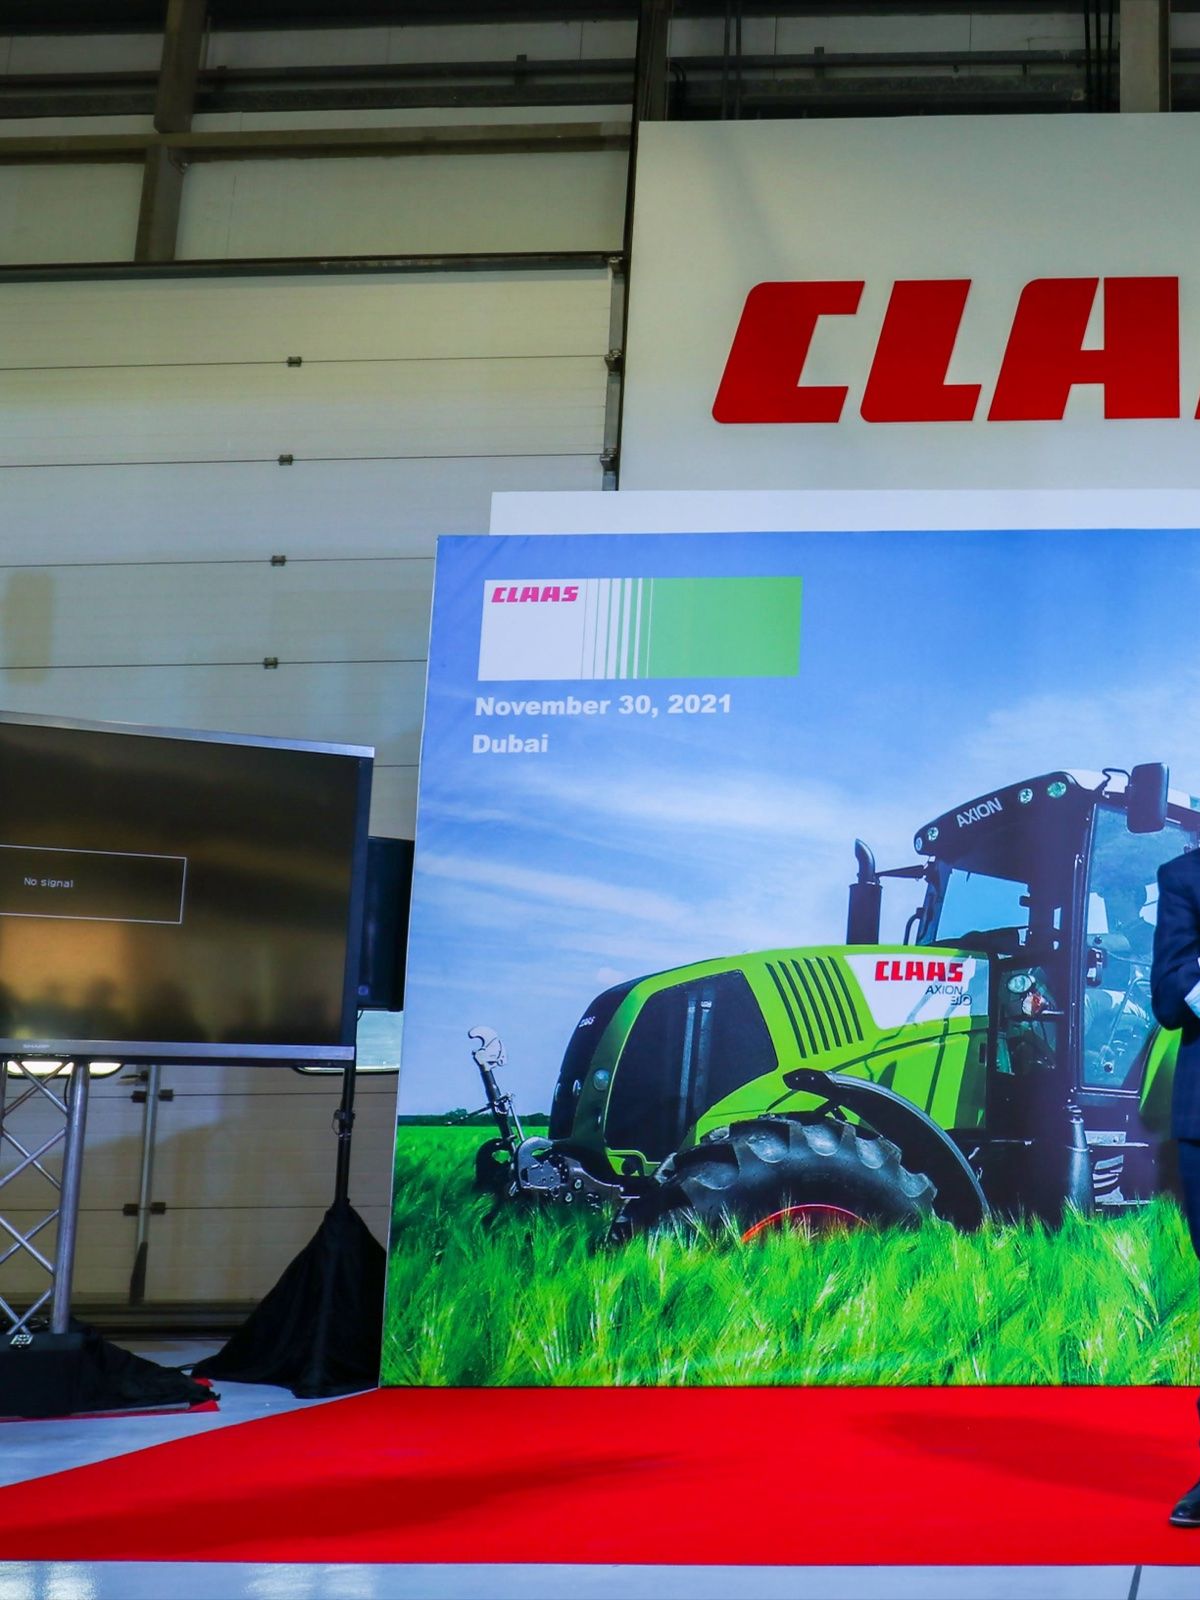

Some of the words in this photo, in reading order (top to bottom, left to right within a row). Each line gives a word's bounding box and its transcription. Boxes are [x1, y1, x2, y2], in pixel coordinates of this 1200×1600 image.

[491, 586, 579, 603] CLAAS
[475, 696, 611, 716] November
[618, 695, 659, 718] 30,
[667, 694, 731, 714] 2021
[472, 733, 549, 753] Dubai
[956, 797, 1003, 828] AXION
[24, 877, 37, 886] No
[40, 879, 74, 888] signal
[875, 961, 964, 982] CLAAS
[925, 984, 963, 995] AXION
